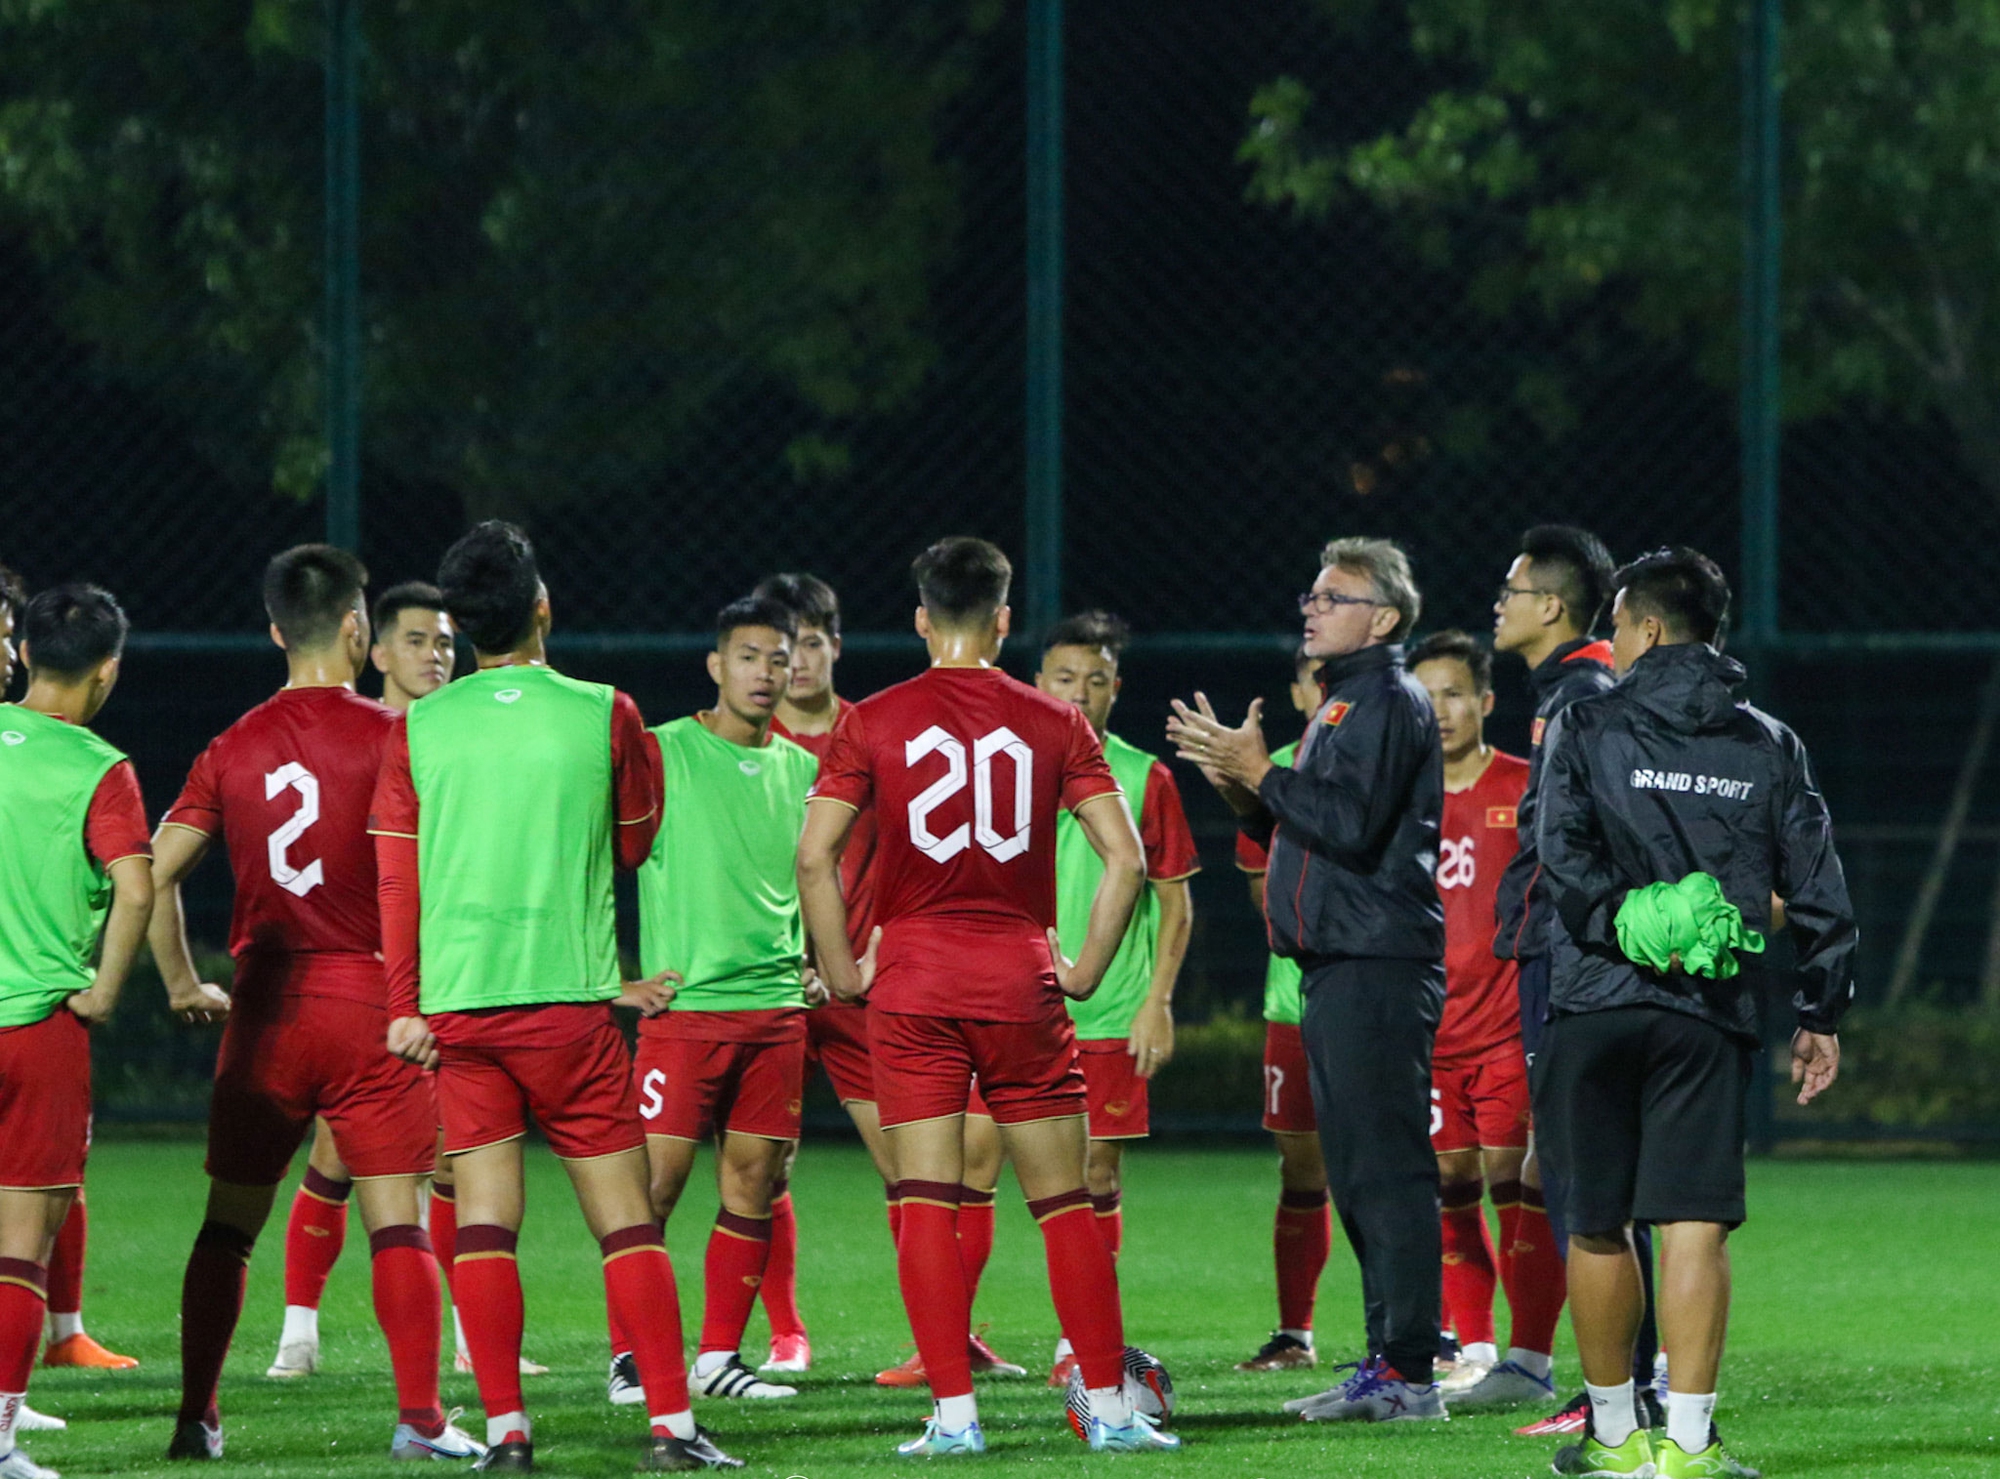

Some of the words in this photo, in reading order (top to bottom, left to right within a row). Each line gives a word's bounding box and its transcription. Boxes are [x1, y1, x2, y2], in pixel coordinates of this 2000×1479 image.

[264, 760, 325, 898] 2
[905, 724, 1034, 865] 20
[1630, 768, 1692, 792] GRAND
[1693, 774, 1754, 801] SPORT
[1436, 835, 1476, 890] 26
